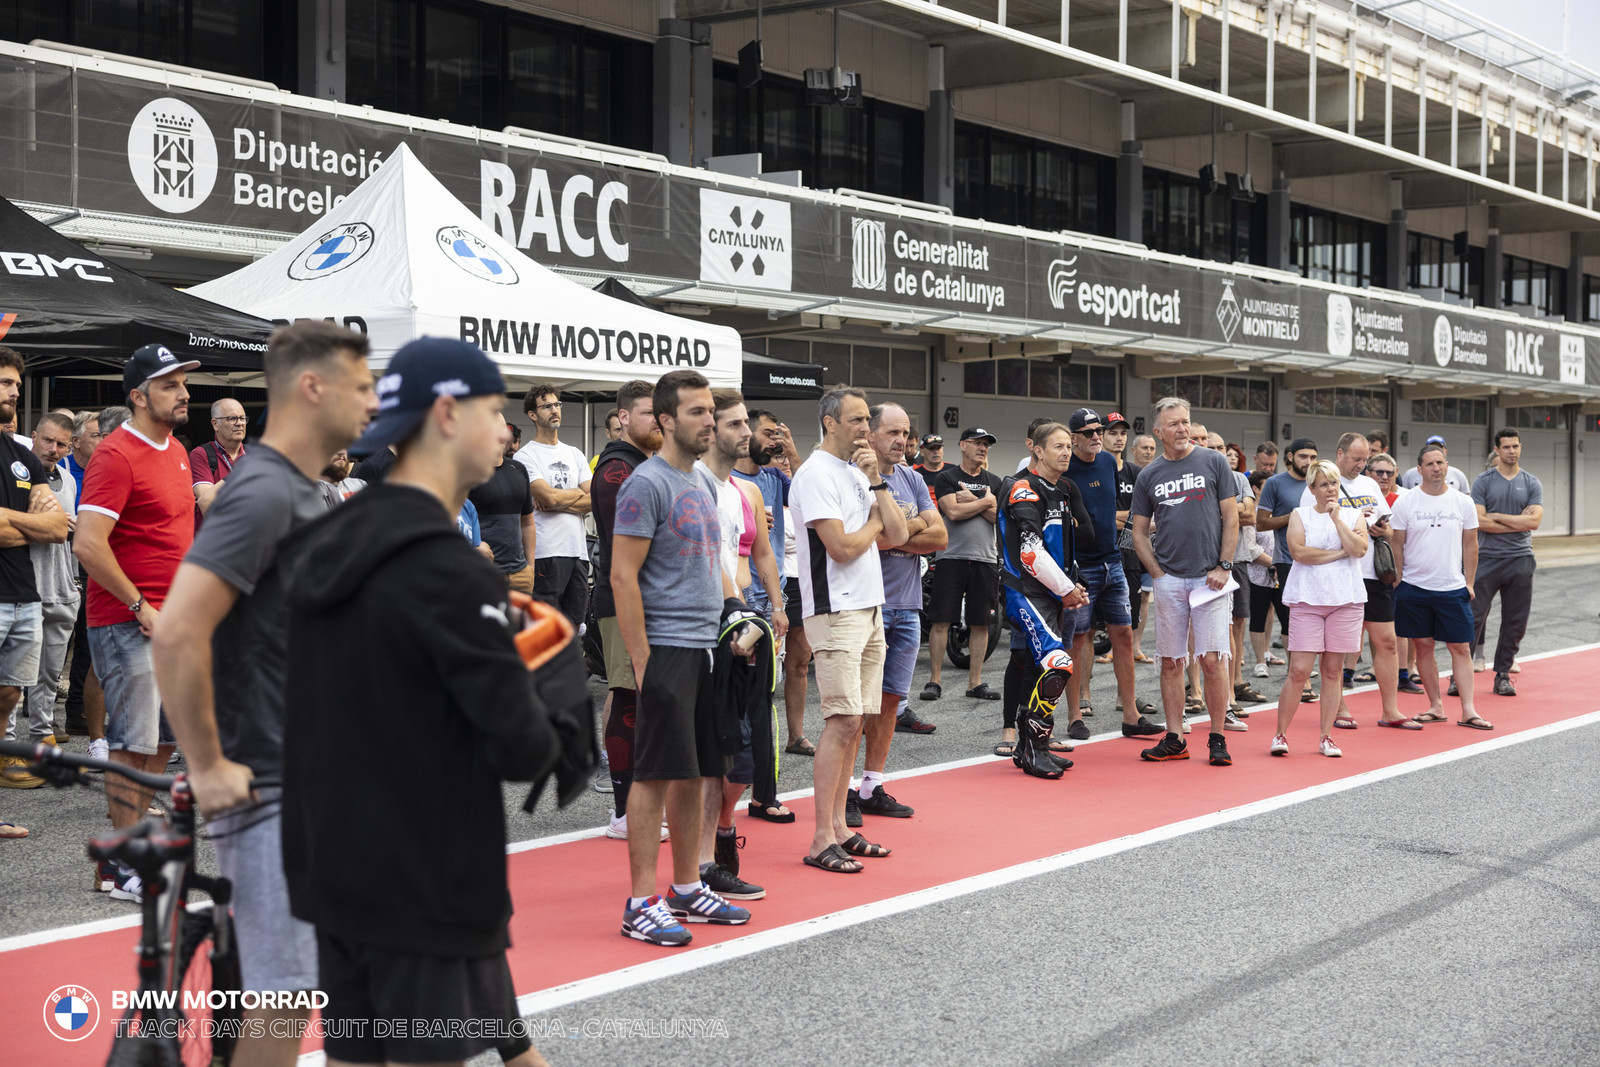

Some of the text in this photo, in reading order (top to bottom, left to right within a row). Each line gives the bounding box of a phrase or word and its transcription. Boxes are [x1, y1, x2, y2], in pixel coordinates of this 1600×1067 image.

[233, 172, 347, 215] Barcel
[480, 159, 629, 262] RACC
[708, 228, 784, 253] CATALUNYA
[893, 230, 989, 271] Generalitat
[0, 251, 115, 283] BMC
[894, 266, 1005, 312] de Catalunya
[1078, 281, 1181, 326] esportcat
[1242, 298, 1300, 319] AJUNTAMENT DE
[1242, 316, 1300, 341] MONTMELÓ
[1354, 306, 1404, 332] Ajuntament
[459, 316, 711, 367] BMW MOTORRAD
[1354, 331, 1409, 356] de Barcelona
[1505, 329, 1544, 376] RACC
[1453, 346, 1488, 366] Barcelona
[769, 373, 816, 387] bmc-moto.com
[947, 410, 958, 425] 23
[1154, 472, 1206, 498] aprilia
